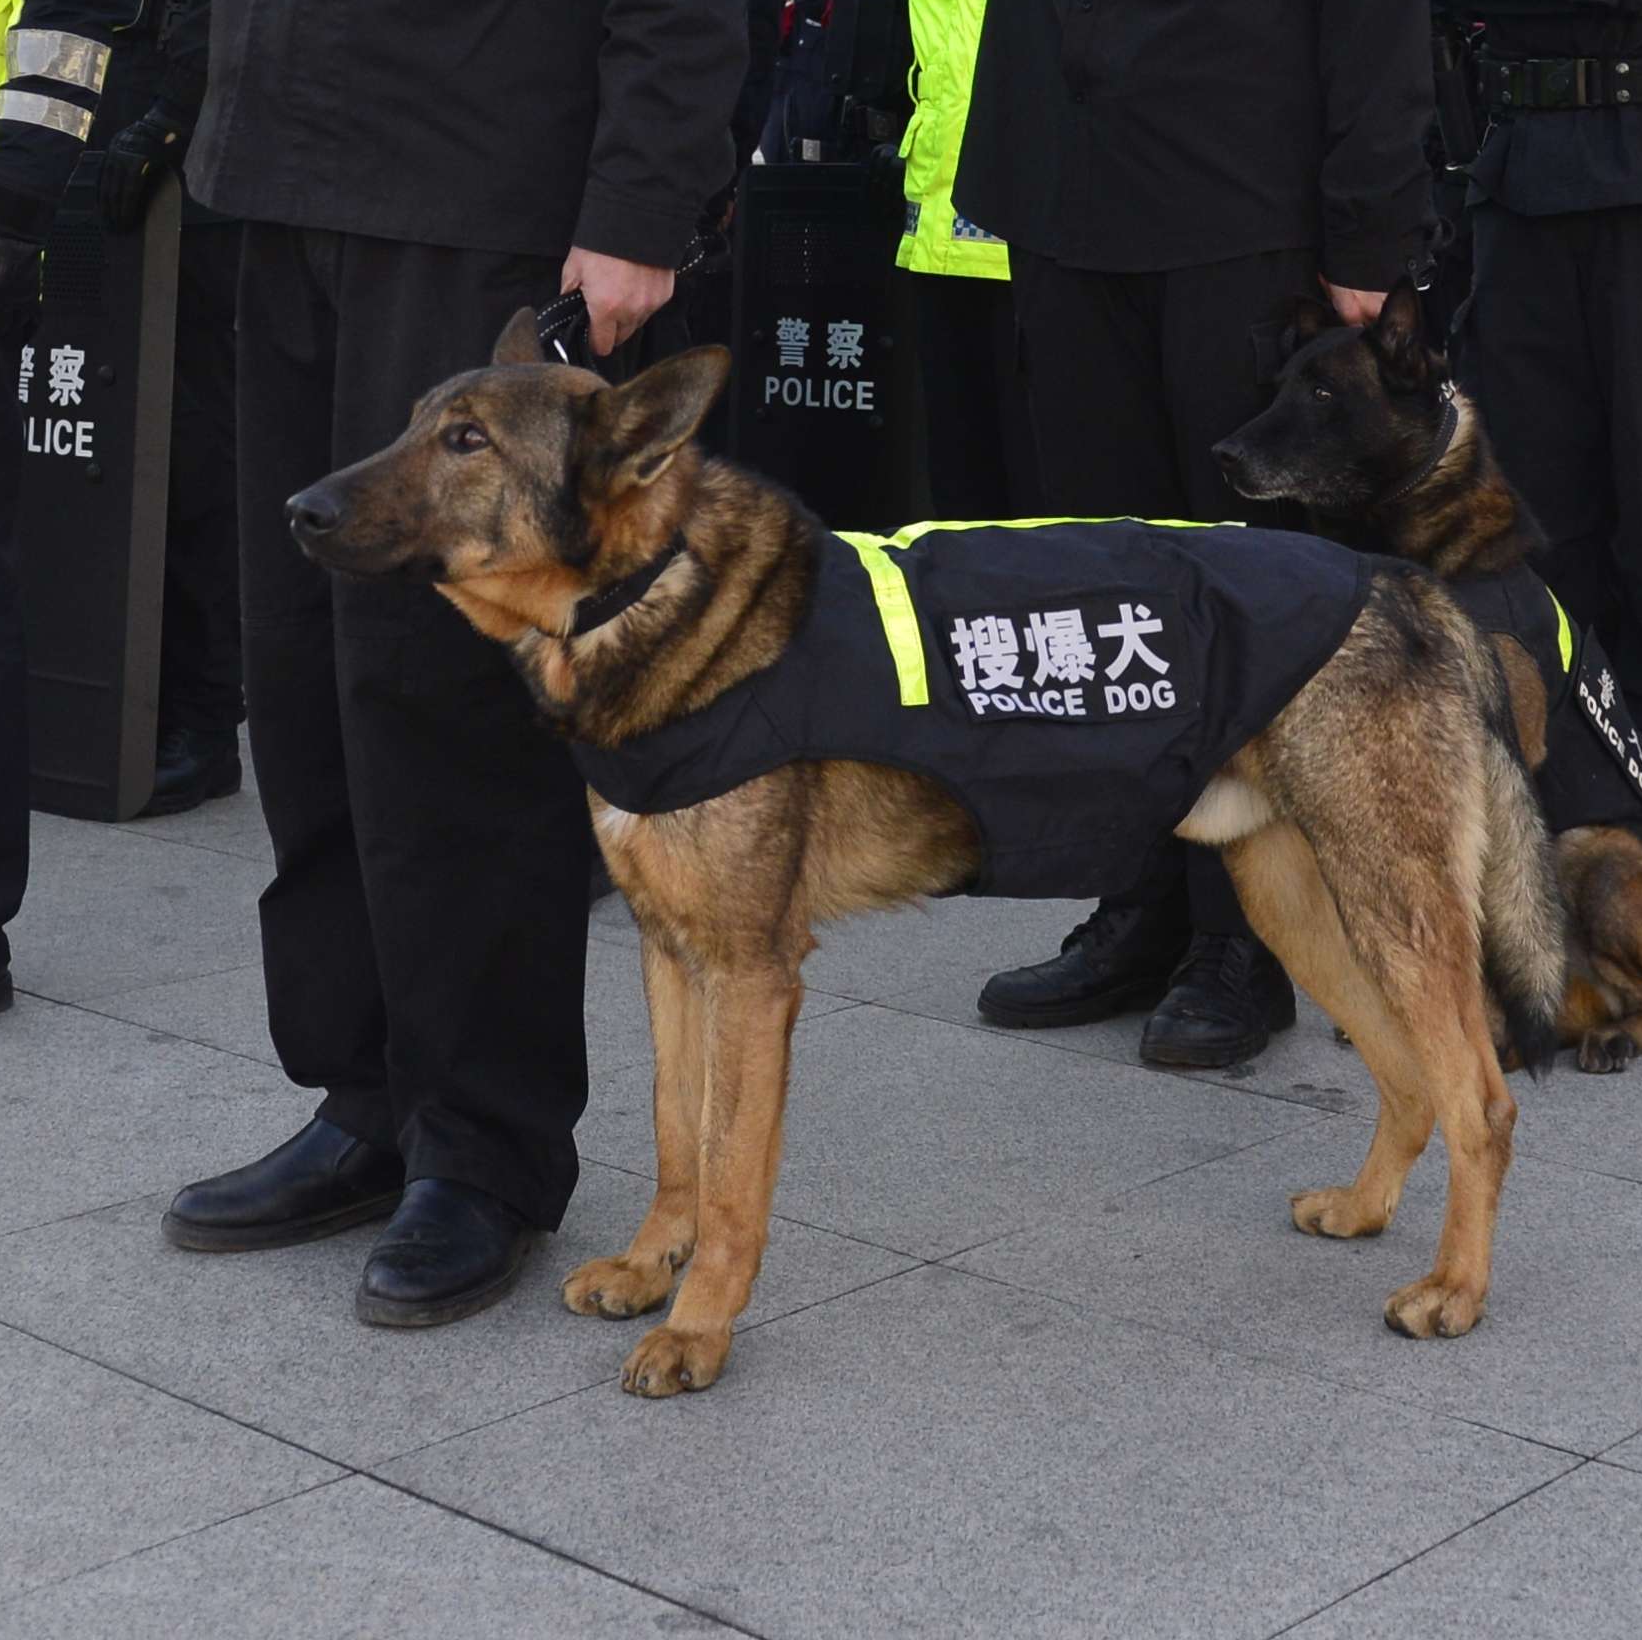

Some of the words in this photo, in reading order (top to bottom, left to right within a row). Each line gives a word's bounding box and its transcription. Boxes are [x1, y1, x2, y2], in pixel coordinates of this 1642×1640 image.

[776, 316, 865, 370] 警察
[764, 375, 875, 411] POLICE
[22, 416, 95, 458] LICE
[949, 602, 1171, 691] 搜爆犬
[966, 687, 1087, 716] POLICE
[1103, 679, 1177, 715] DOG
[1578, 680, 1626, 759] POLICE
